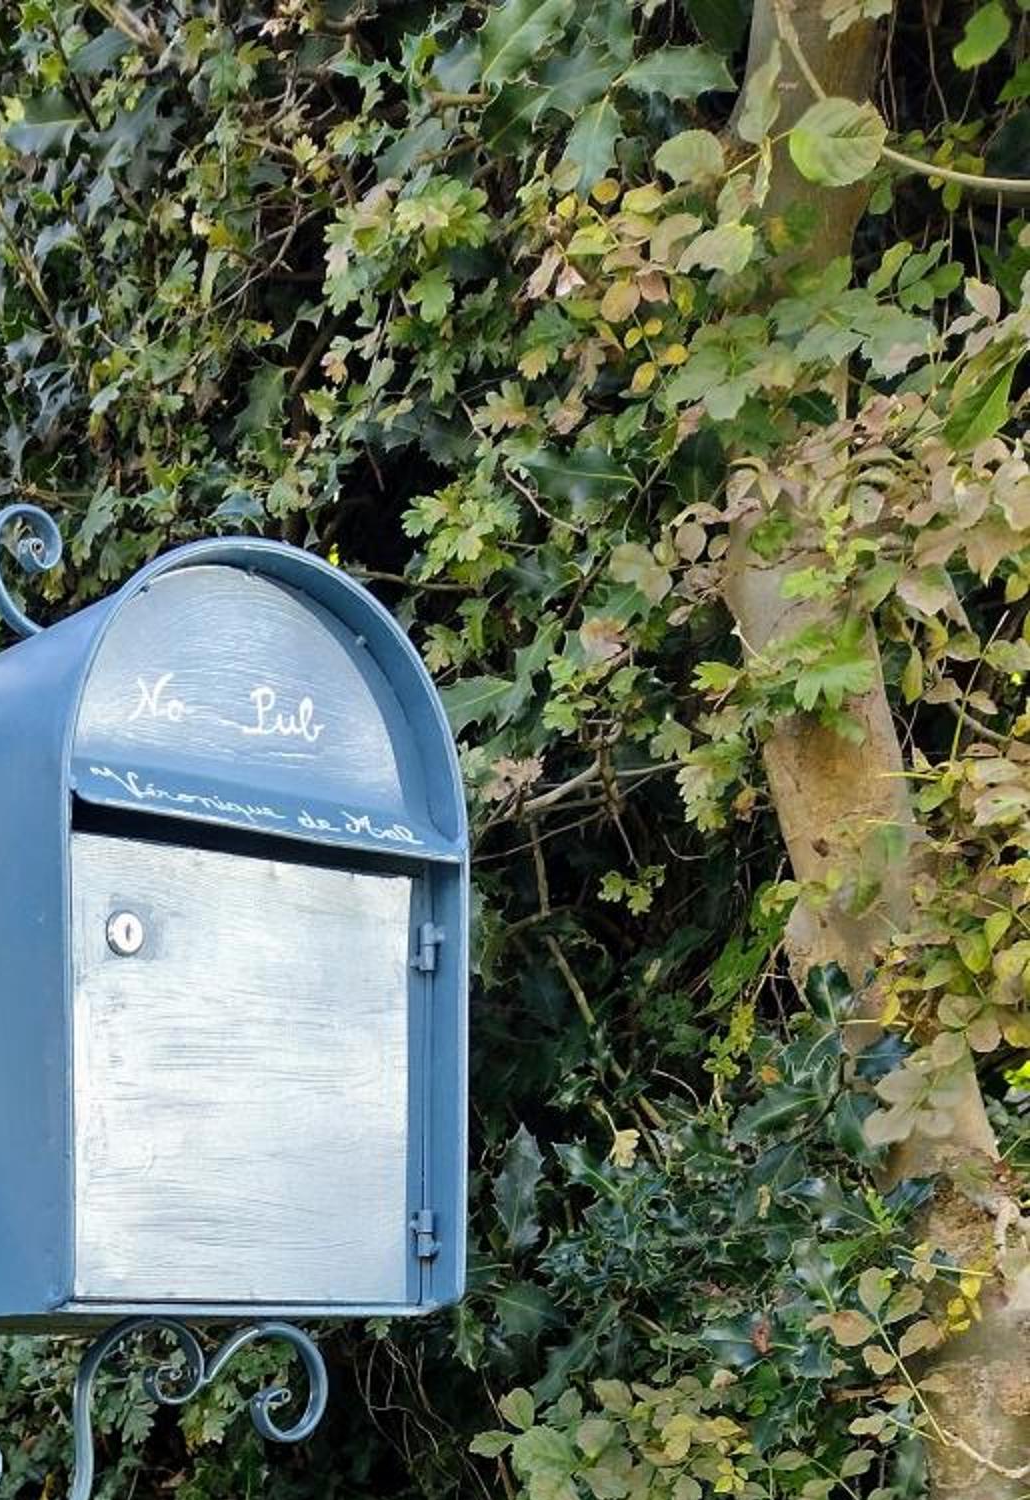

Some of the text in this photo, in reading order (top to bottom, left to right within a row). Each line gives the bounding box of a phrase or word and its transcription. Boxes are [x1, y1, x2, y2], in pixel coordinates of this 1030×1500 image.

[127, 673, 325, 741] No Pub
[88, 766, 287, 821] Véronique
[296, 808, 342, 833] de
